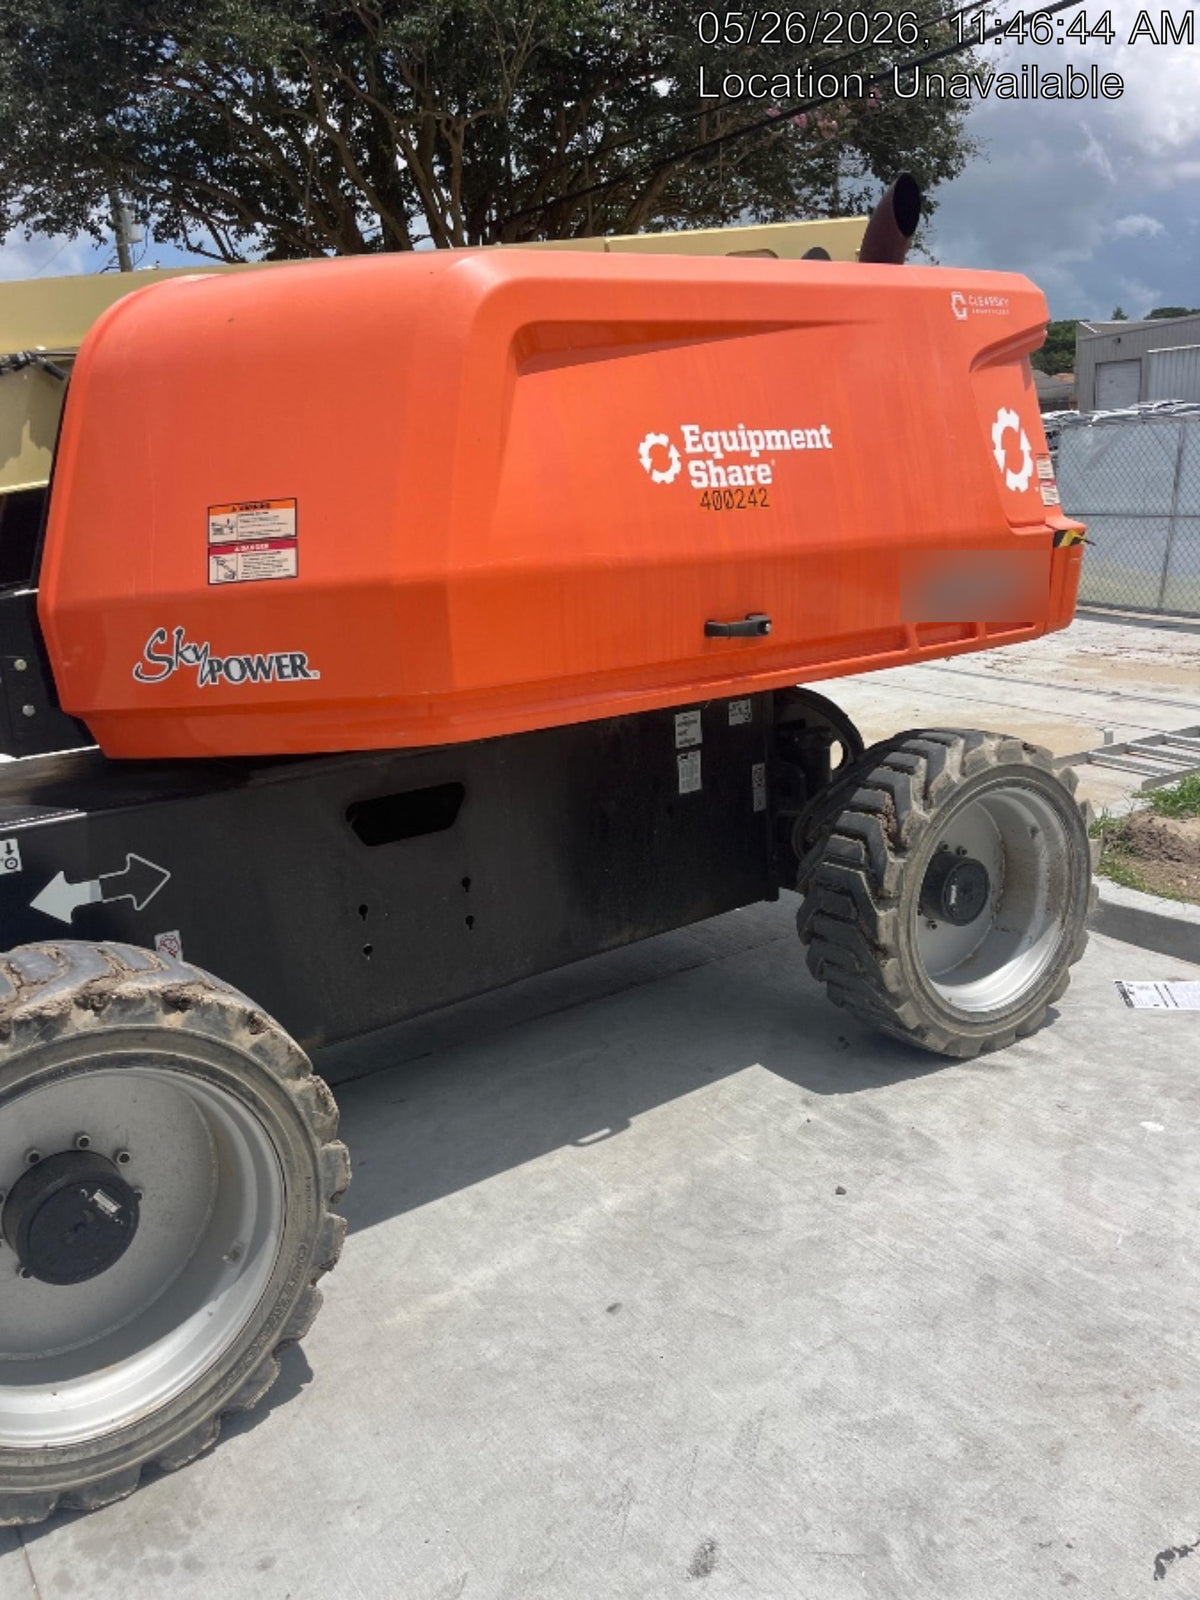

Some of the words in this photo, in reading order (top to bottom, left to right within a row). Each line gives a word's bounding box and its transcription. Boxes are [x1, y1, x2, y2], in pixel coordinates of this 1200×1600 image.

[680, 423, 833, 459] Equipment
[687, 460, 773, 488] Share
[700, 487, 771, 511] 400242
